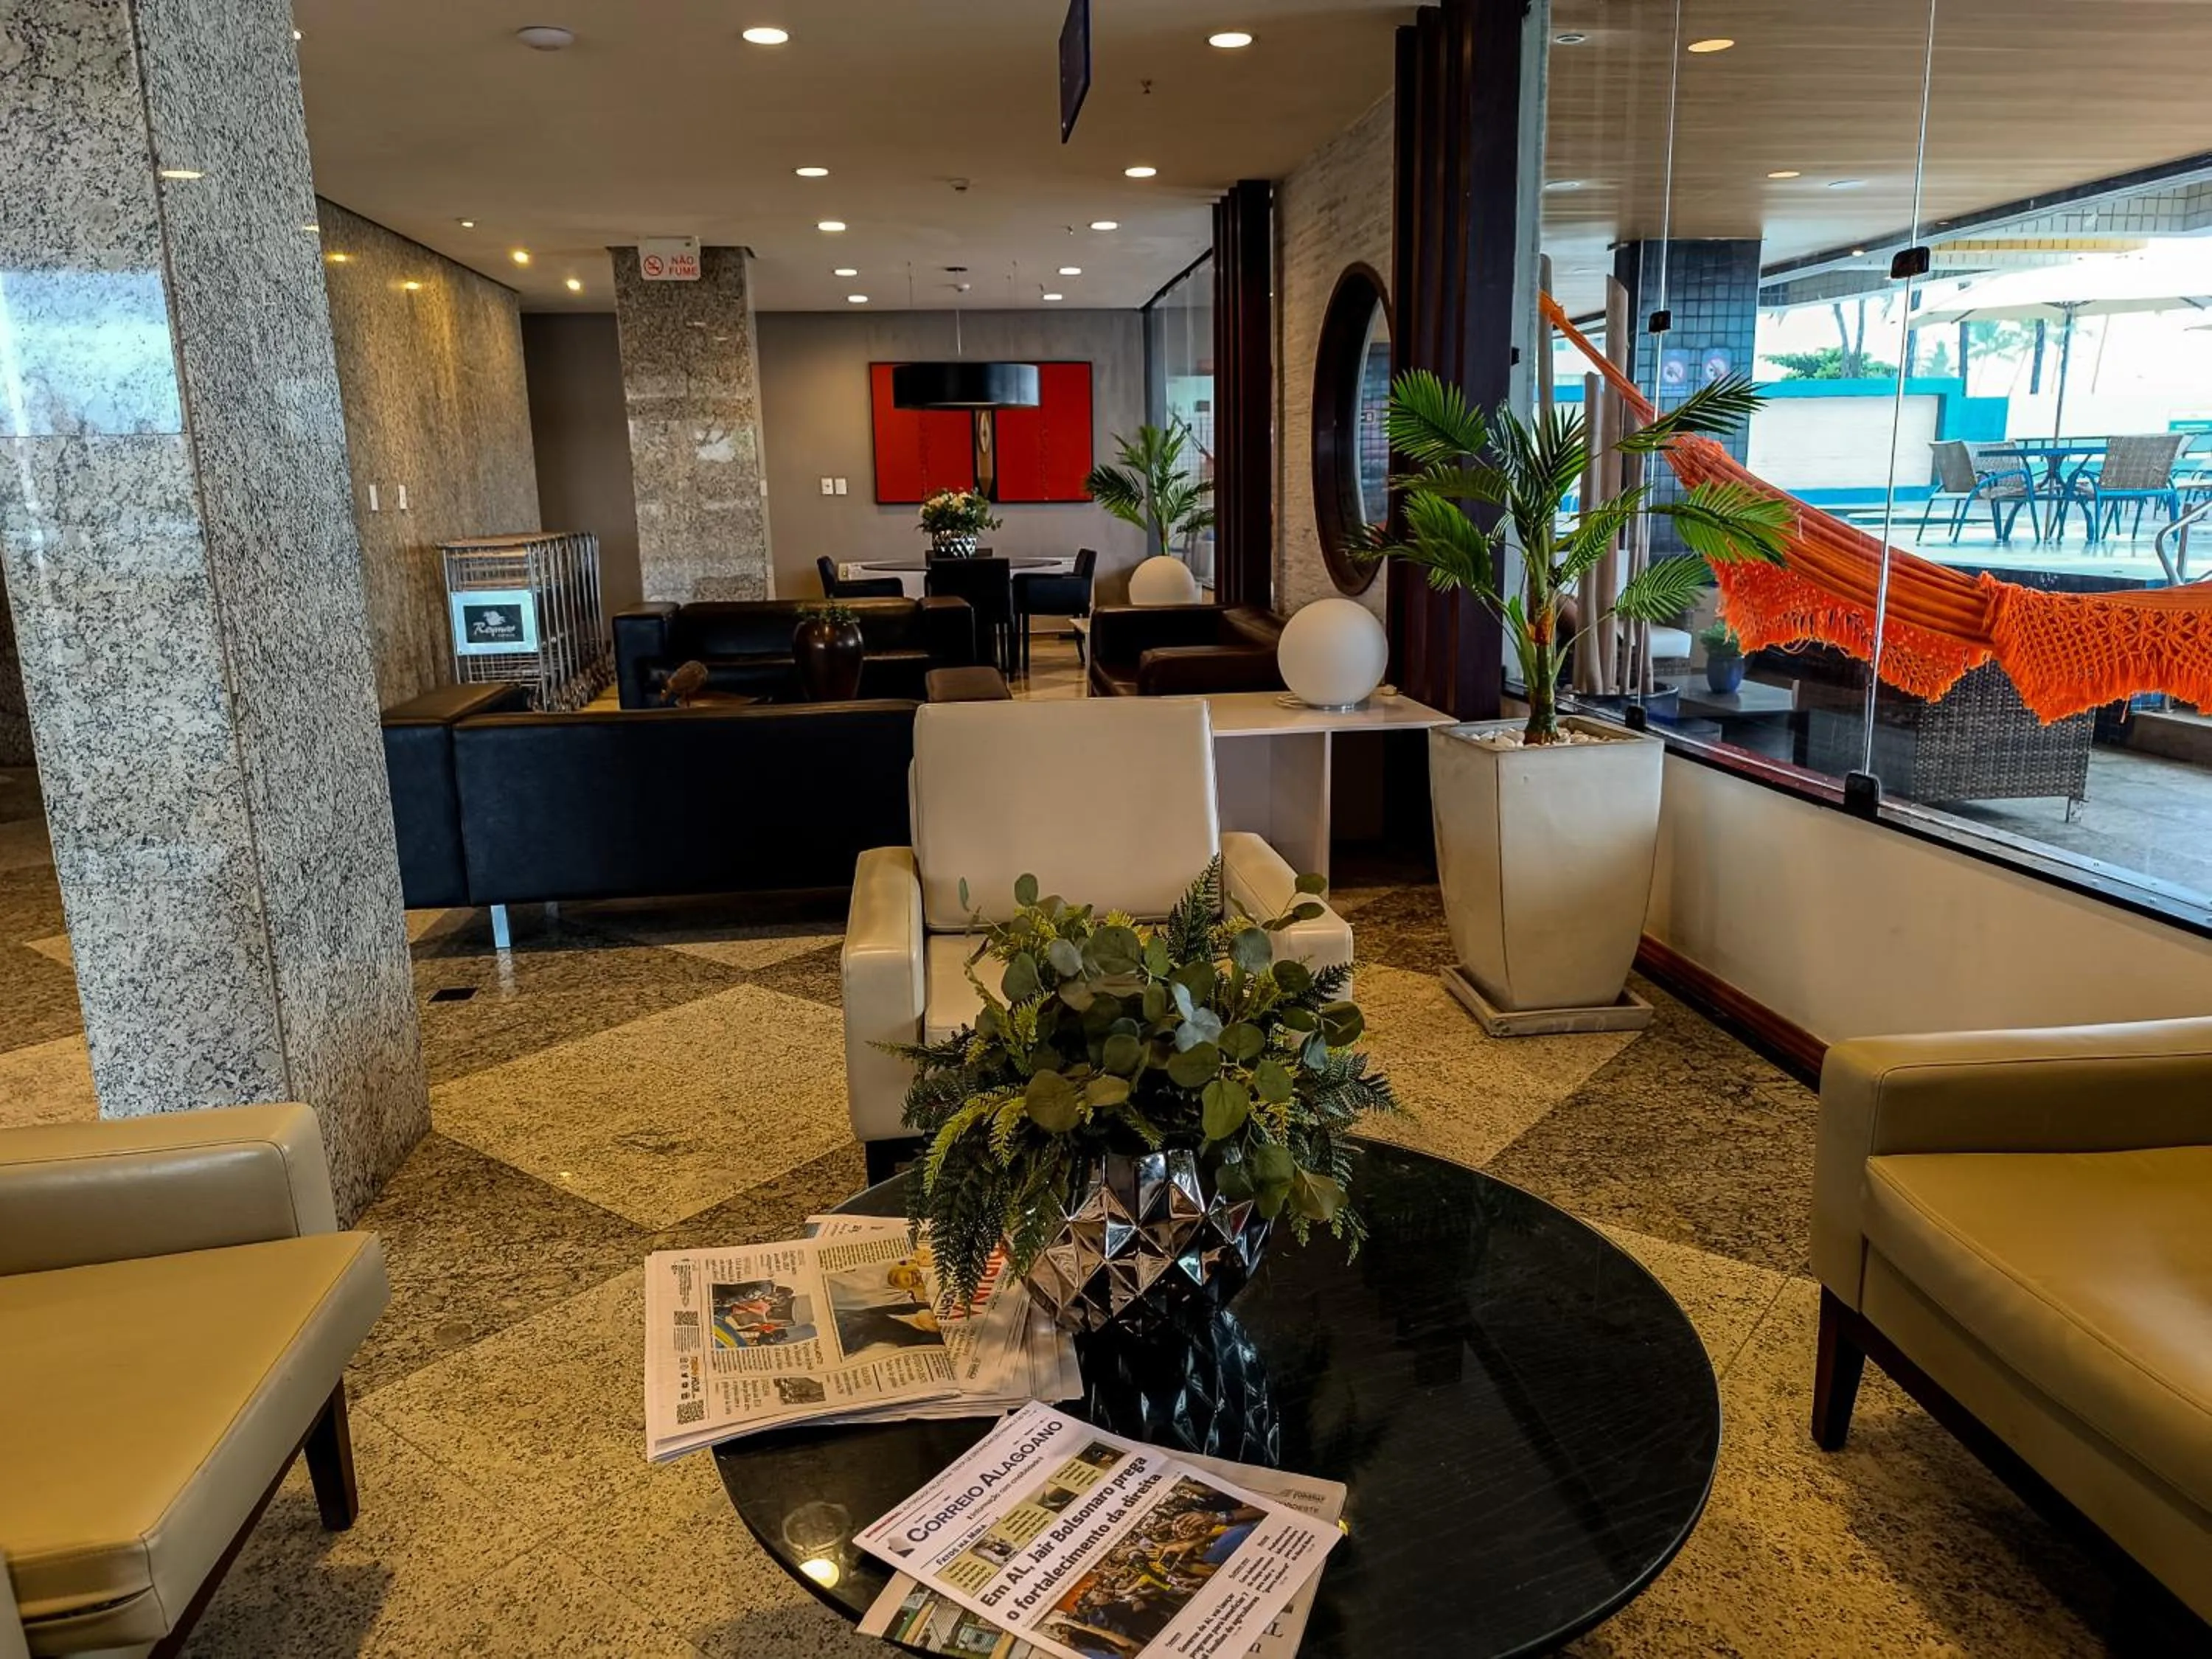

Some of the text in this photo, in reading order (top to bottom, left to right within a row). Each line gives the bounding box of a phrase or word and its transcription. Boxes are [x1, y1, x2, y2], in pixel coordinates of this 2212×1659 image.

[669, 266, 698, 276] FUME
[906, 1486, 984, 1543] CORREIO
[979, 1420, 1063, 1488] ALAGOANO
[980, 1584, 1011, 1607] Em
[1006, 1564, 1034, 1585] AL,
[1028, 1540, 1055, 1564] Jair
[1050, 1486, 1115, 1543] Bolsonaro
[1112, 1455, 1147, 1490] prega
[1006, 1610, 1020, 1621] o
[1013, 1523, 1111, 1610] fortalecimento
[1107, 1507, 1127, 1524] da
[1121, 1474, 1162, 1508] direita
